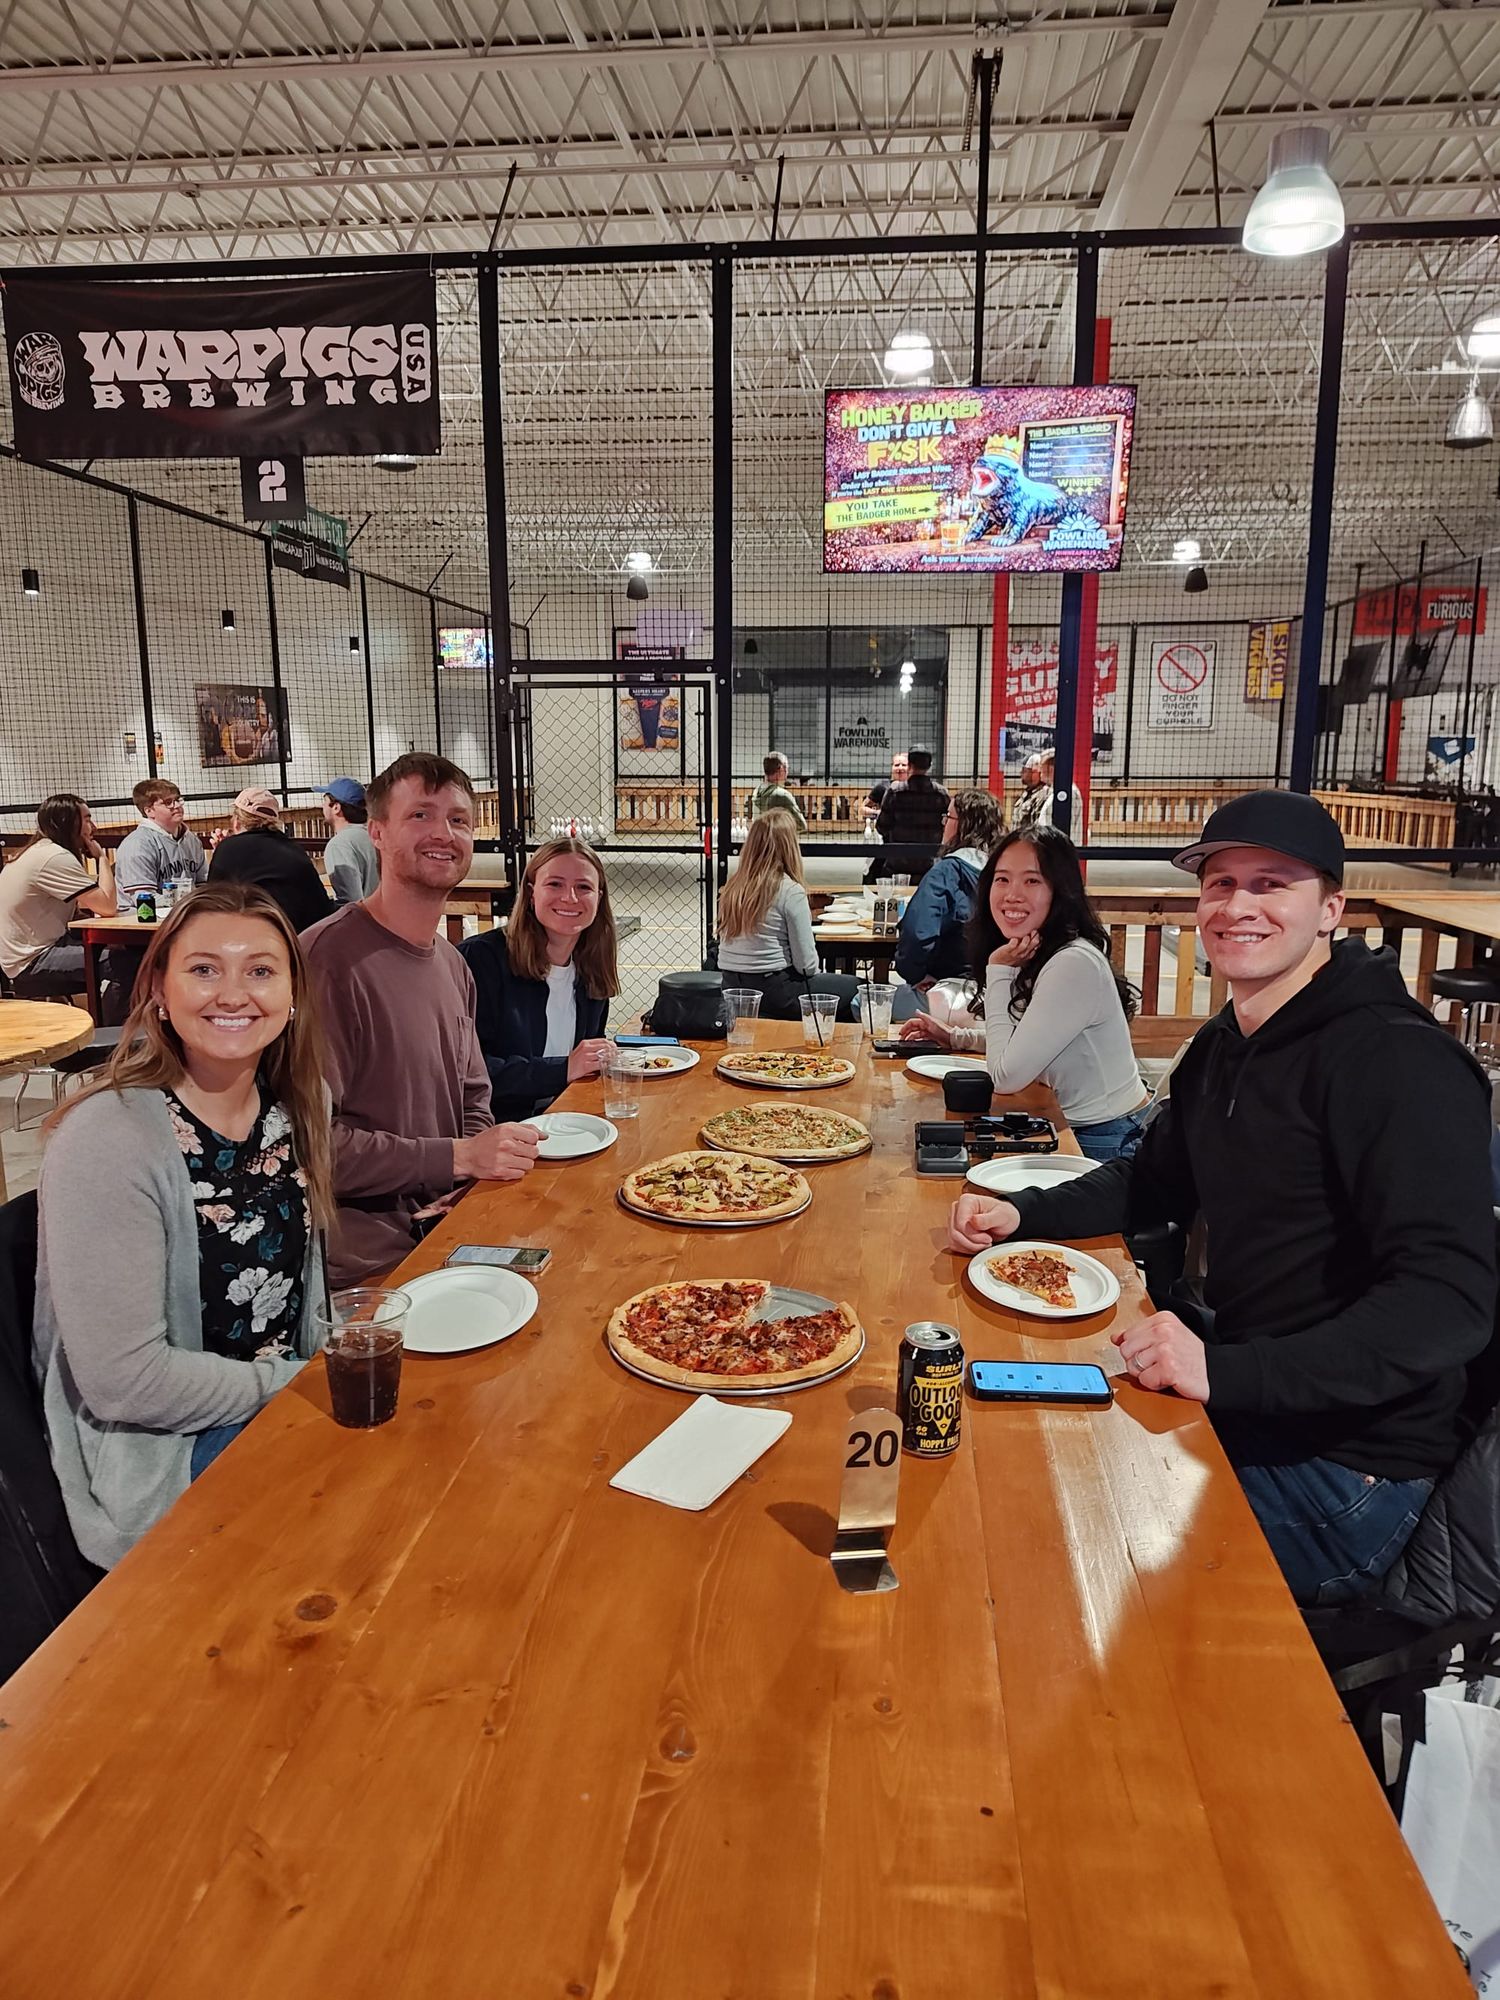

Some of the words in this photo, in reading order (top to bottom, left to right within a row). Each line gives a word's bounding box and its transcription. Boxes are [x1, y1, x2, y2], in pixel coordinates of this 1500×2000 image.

[78, 324, 400, 382] WARPIGS
[405, 329, 426, 397] USA
[91, 379, 398, 409] BREWING
[841, 405, 907, 428] HONEY
[910, 400, 983, 422] BADGER
[858, 424, 905, 442] DON'T
[906, 421, 943, 437] GIVE
[944, 420, 956, 434] A
[1045, 426, 1078, 437] BADGER
[1080, 422, 1112, 434] BOARD
[258, 460, 287, 502] 2
[1057, 477, 1102, 488] WINNER
[846, 502, 869, 512] YOU
[872, 498, 898, 508] TAKE
[836, 514, 854, 522] THE
[893, 506, 917, 516] HOME
[1049, 529, 1108, 541] FOWLING
[1042, 540, 1111, 551] WAREHOUSE
[1427, 602, 1474, 619] FURIOUS
[1247, 626, 1265, 697] VIKINGS
[1270, 634, 1288, 688] SKOL
[1162, 694, 1178, 702] DO
[1180, 694, 1199, 702] NOT
[1162, 702, 1199, 710] FINGER
[839, 727, 886, 737] FOWLING
[834, 737, 890, 749] WAREHOUSE
[874, 901, 885, 911] 05
[888, 902, 898, 911] 24
[910, 1383, 962, 1408] OUTLOO
[921, 1402, 961, 1422] GOOD
[845, 1429, 898, 1468] 20
[920, 1438, 945, 1448] HOPPY
